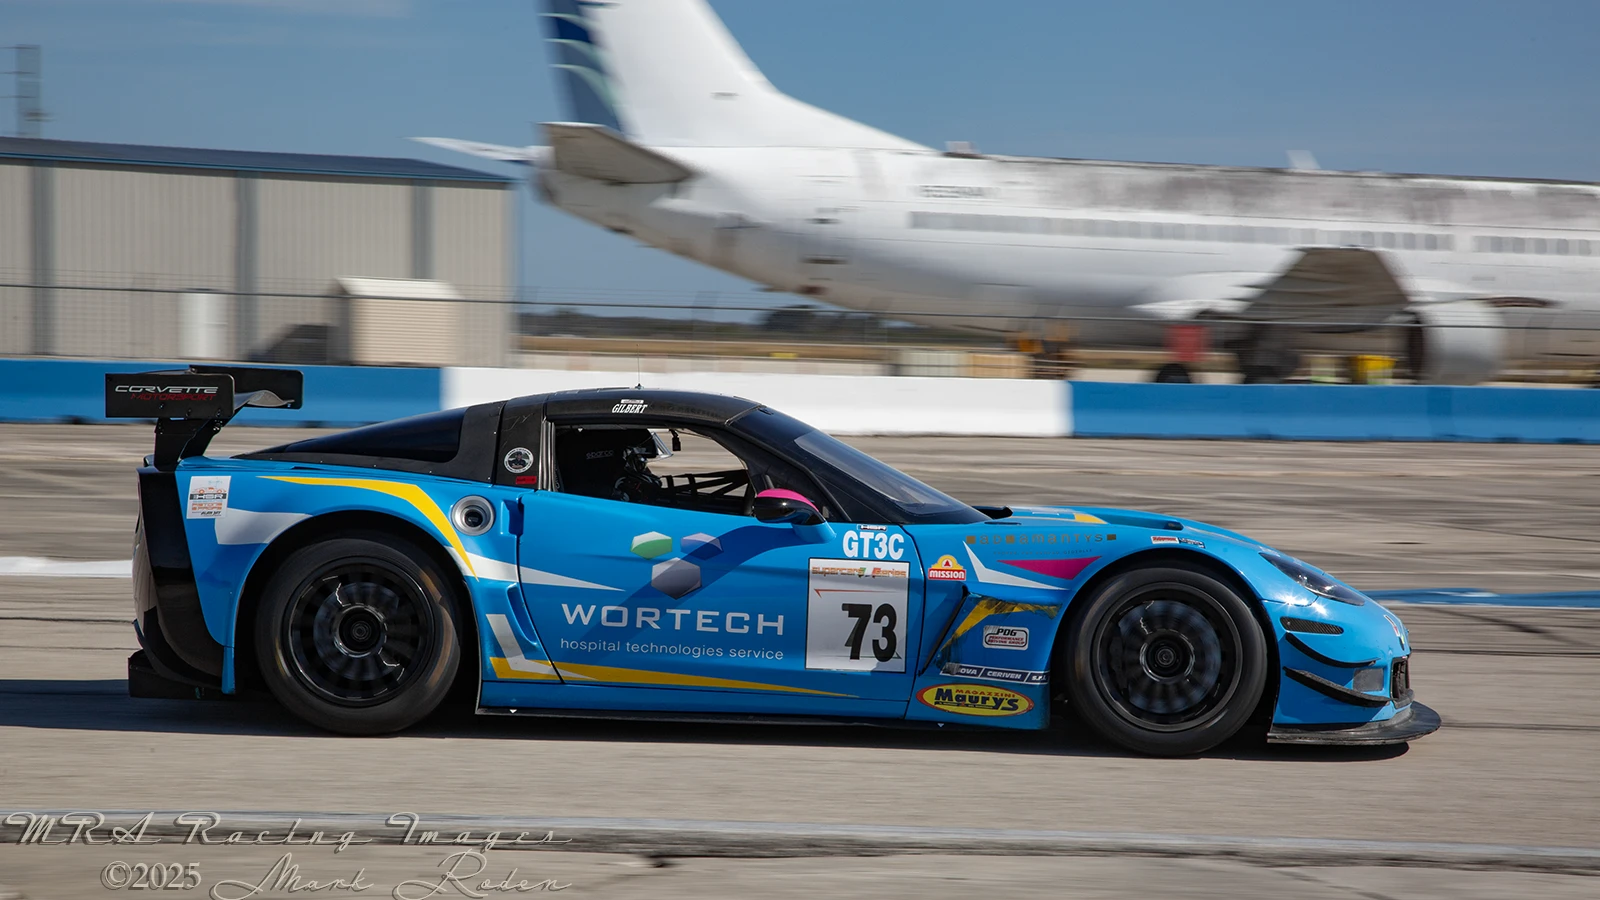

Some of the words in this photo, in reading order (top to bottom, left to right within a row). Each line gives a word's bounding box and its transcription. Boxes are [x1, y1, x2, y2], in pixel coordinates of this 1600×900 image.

[115, 385, 219, 394] CORVETTE
[130, 393, 217, 401] MOTORSPORT
[611, 403, 648, 414] GILBERT
[842, 530, 905, 560] GT3C
[929, 570, 965, 579] MISSION
[561, 603, 785, 636] WORTECH
[842, 603, 897, 662] 73
[996, 628, 1017, 637] PDG
[560, 638, 620, 653] hospital
[626, 642, 724, 658] technologies
[729, 648, 785, 661] service
[986, 670, 1022, 680] CERIVEN
[934, 687, 1020, 711] Maury's
